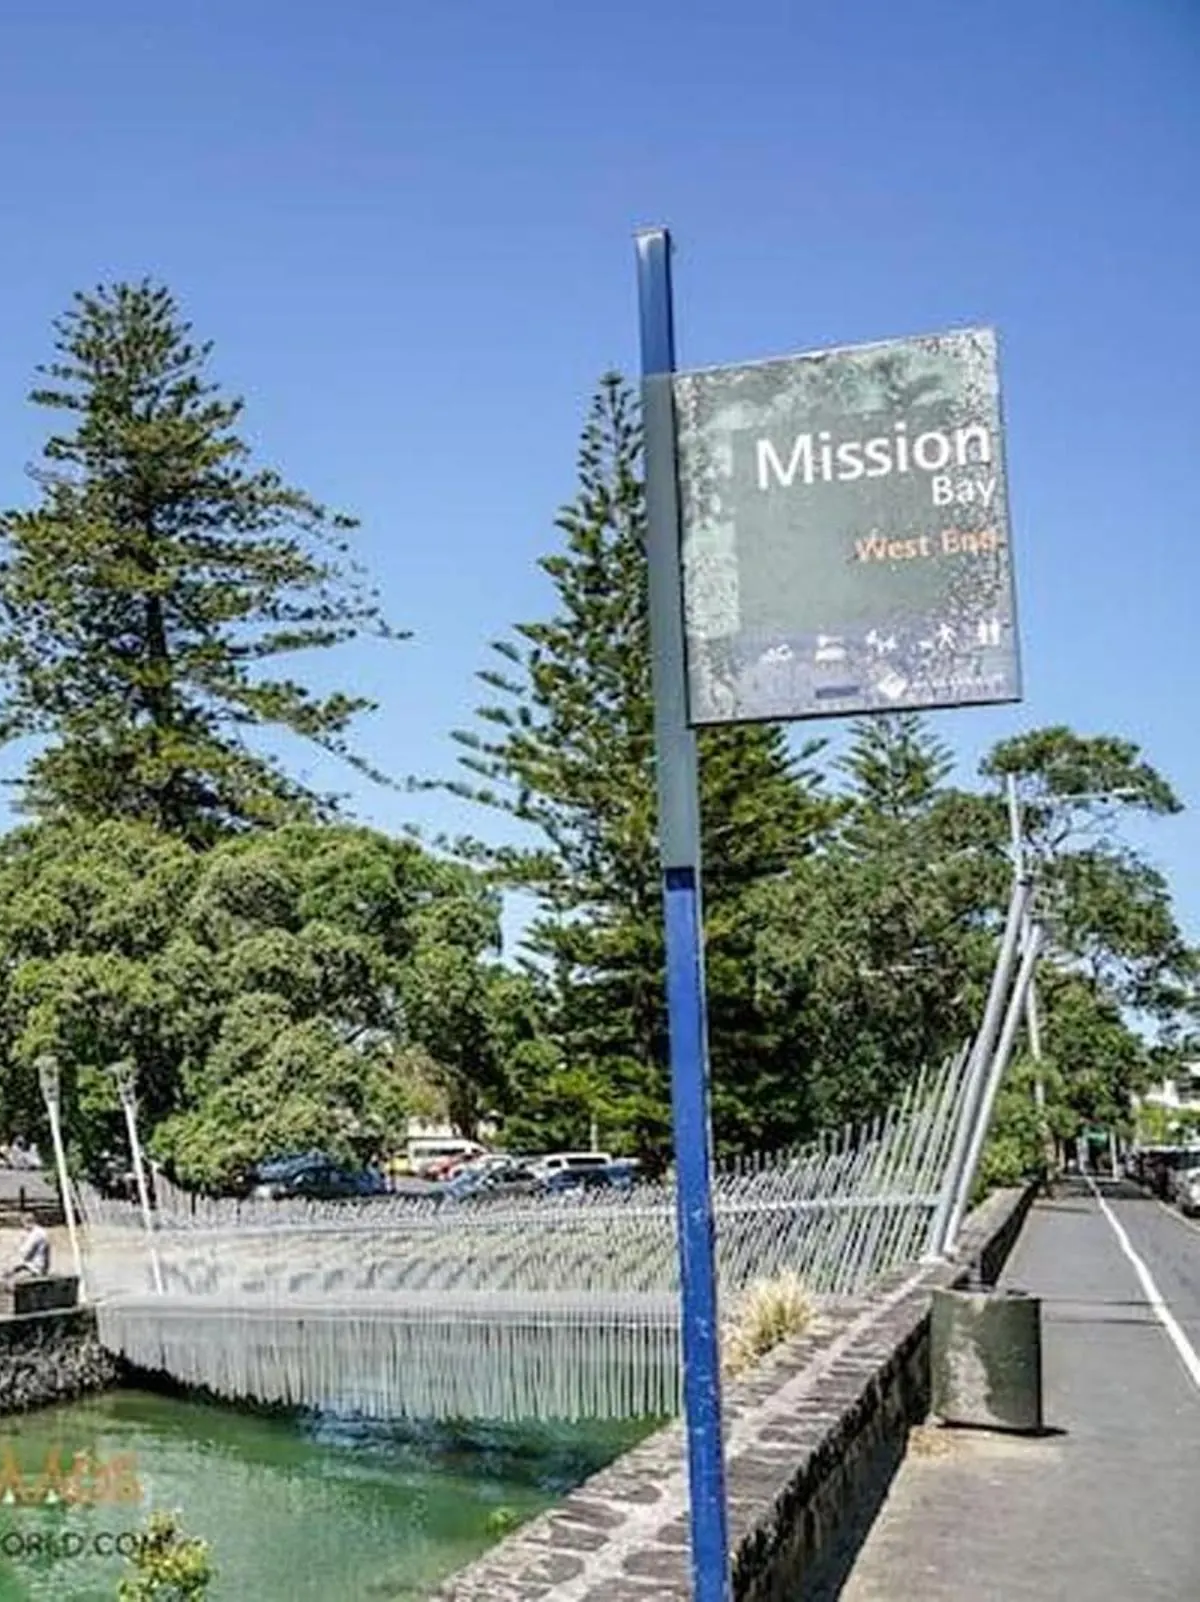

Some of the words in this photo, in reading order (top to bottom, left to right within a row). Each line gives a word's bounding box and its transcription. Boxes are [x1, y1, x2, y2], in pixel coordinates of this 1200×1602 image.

[757, 422, 992, 490] Mission
[932, 475, 996, 507] Bay
[855, 532, 930, 563] West
